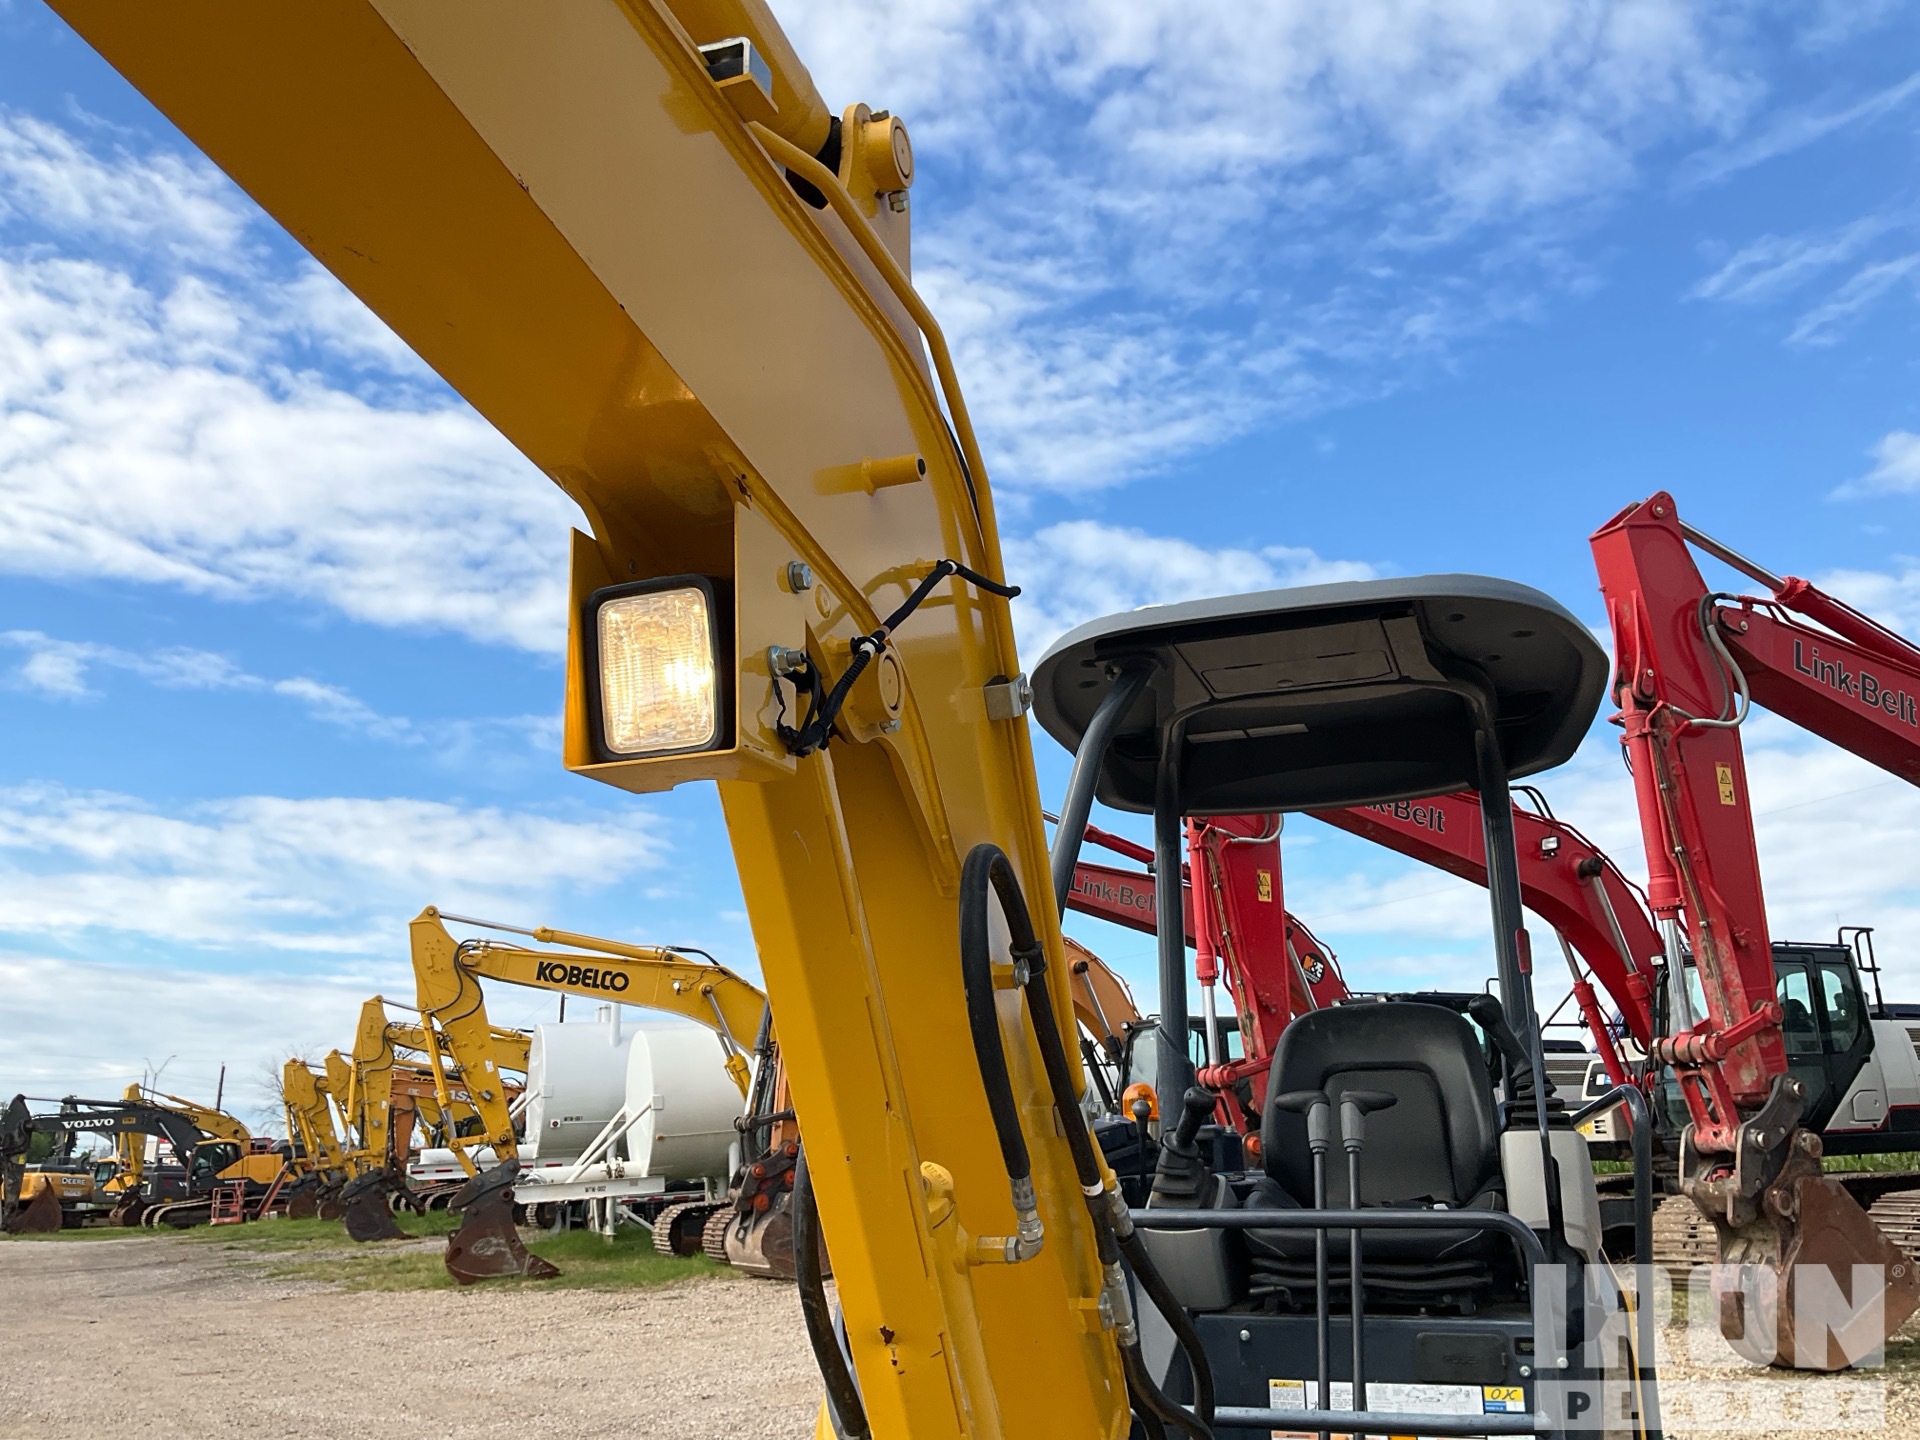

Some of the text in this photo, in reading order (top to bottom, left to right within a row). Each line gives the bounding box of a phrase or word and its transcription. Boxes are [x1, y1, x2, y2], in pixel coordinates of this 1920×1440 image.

[1069, 872, 1156, 912] Link-Bel
[536, 961, 629, 991] KOBELCO
[61, 1118, 115, 1129] VOLVO
[62, 1177, 86, 1185] DEERE
